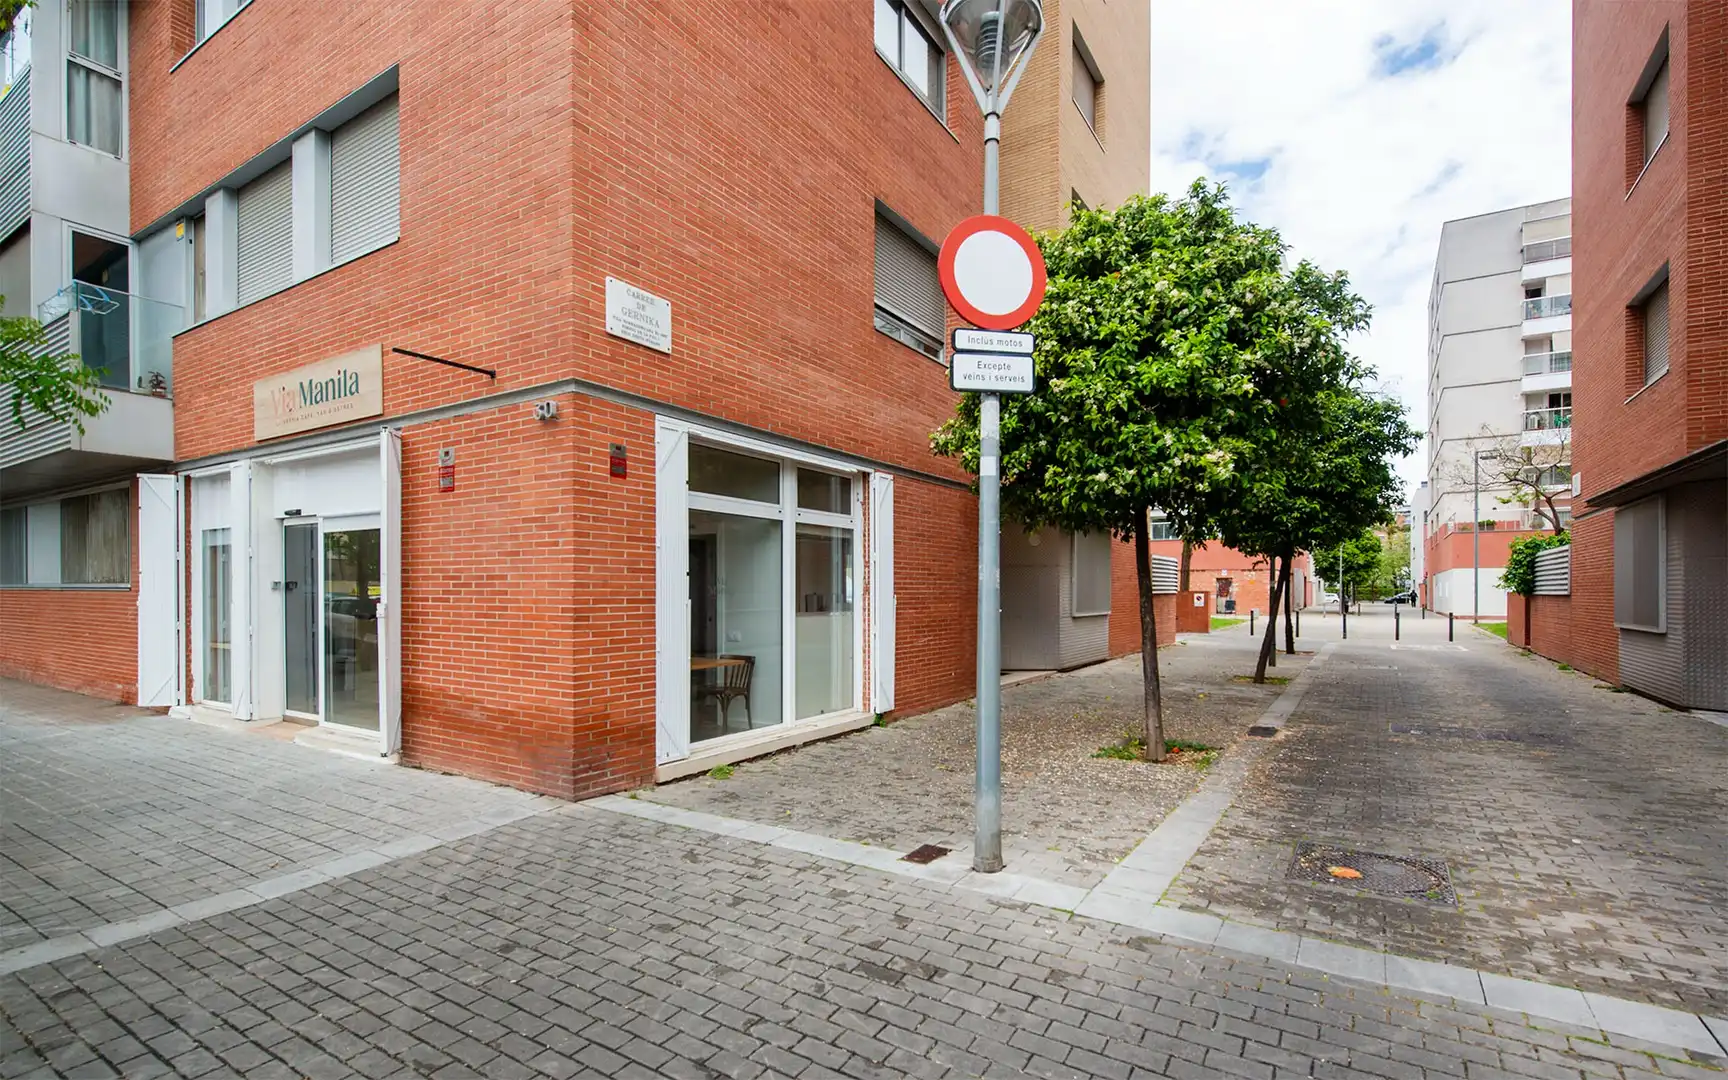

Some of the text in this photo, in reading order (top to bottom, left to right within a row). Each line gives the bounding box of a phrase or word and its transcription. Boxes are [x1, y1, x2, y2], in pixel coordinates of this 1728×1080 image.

[621, 306, 660, 328] GERNIKA
[996, 339, 1023, 348] motos
[977, 360, 1012, 371] Excepte
[994, 374, 1026, 383] serveis
[533, 400, 554, 419] 30
